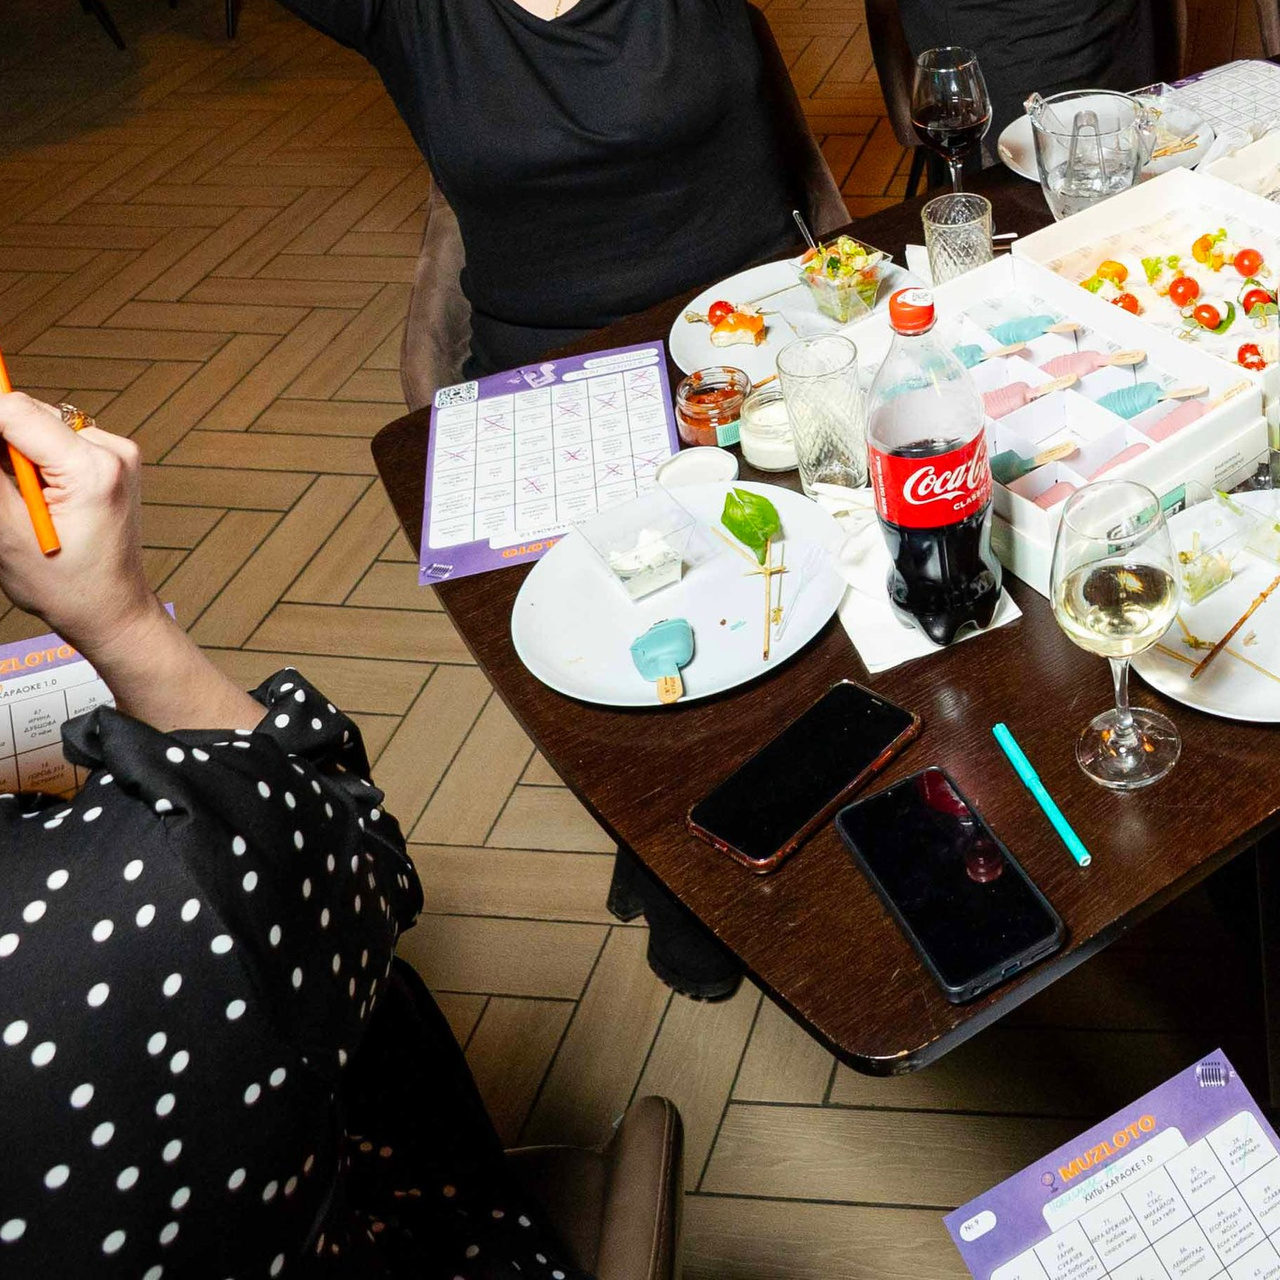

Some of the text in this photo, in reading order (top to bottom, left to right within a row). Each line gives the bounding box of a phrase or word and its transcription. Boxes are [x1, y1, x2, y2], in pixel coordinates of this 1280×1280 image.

[0, 645, 76, 674] ZLOTO
[1058, 1114, 1157, 1182] MUZLOTO
[1083, 1186, 1105, 1203] ХИТЫ
[1104, 1162, 1142, 1189] КАРАОКЕ
